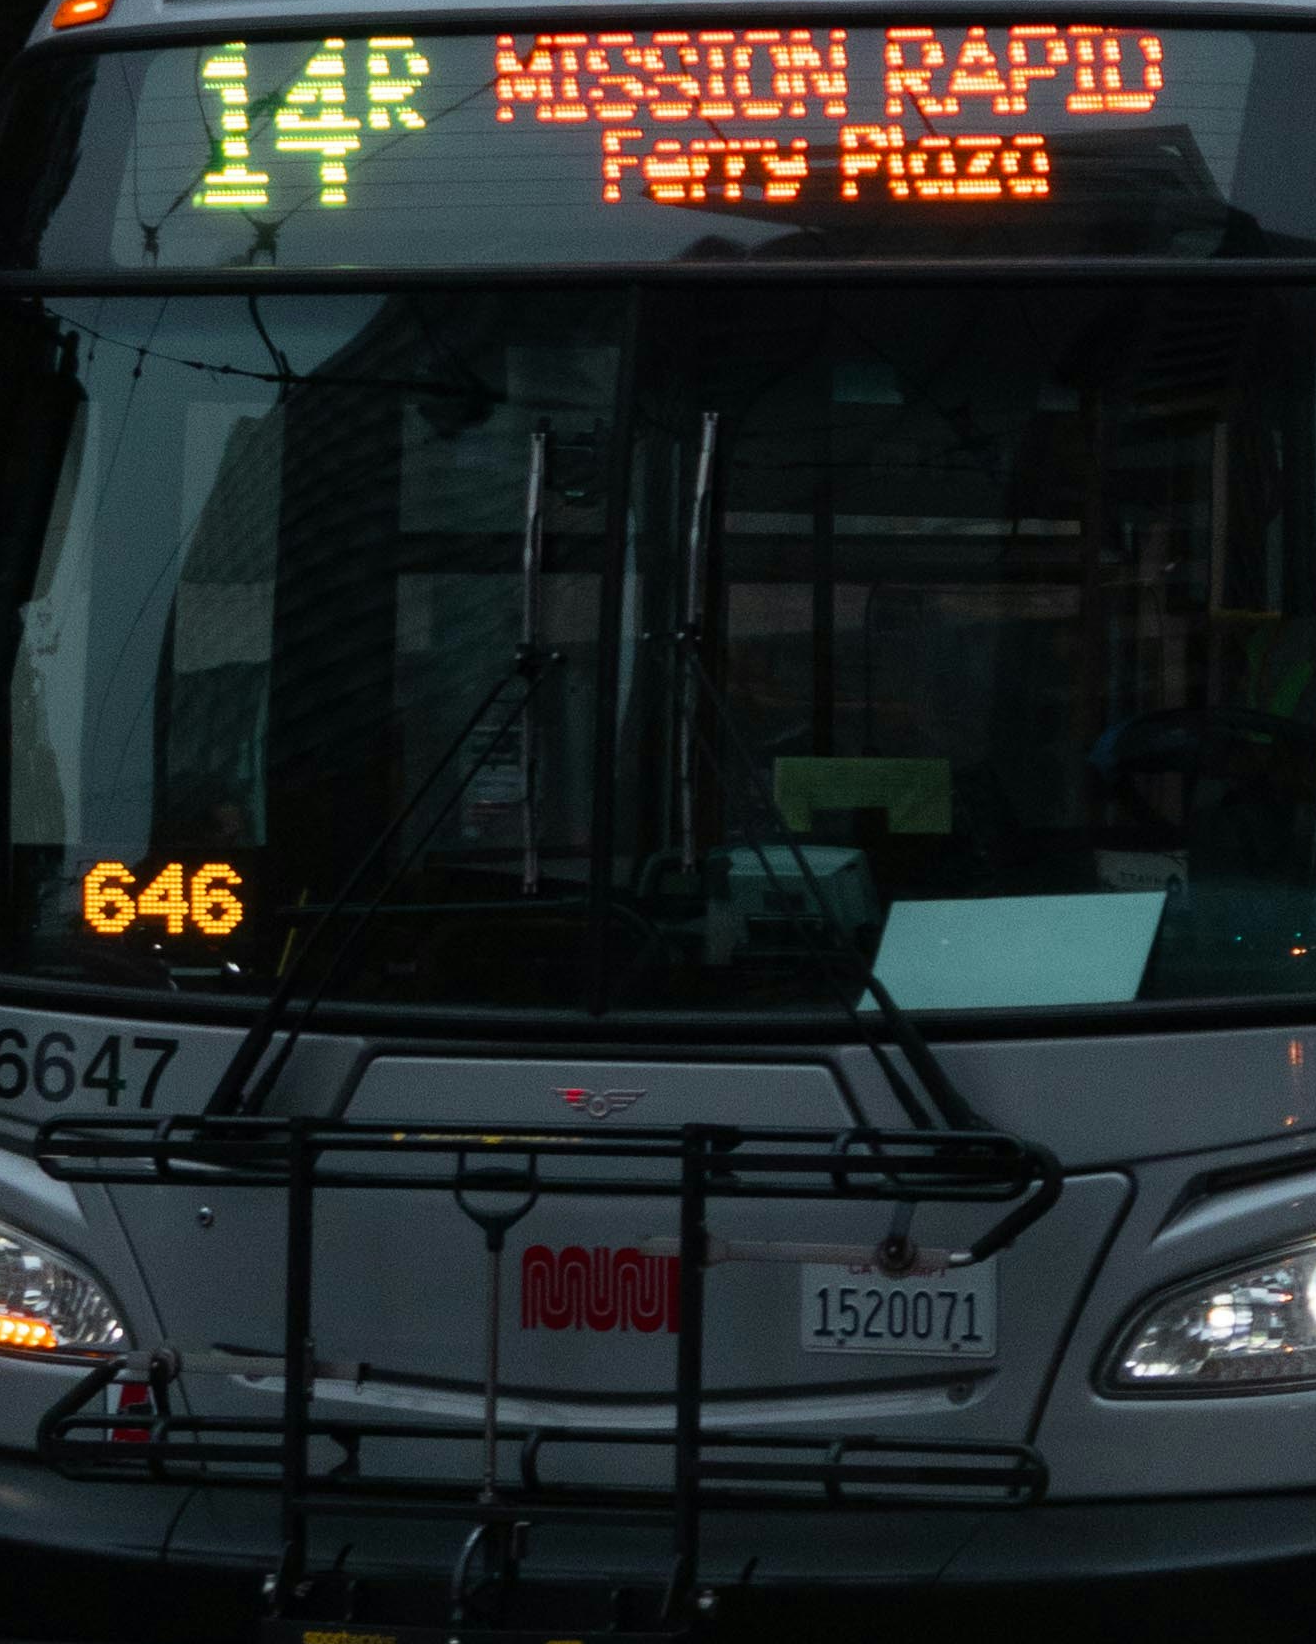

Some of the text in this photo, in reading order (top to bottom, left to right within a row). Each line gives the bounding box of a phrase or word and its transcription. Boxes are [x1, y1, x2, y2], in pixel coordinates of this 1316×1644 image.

[201, 25, 1164, 206] 14R MISSION RAPID
[602, 123, 1050, 204] Ferry Plaza
[84, 861, 244, 936] 646
[812, 1287, 983, 1342] 1520071
